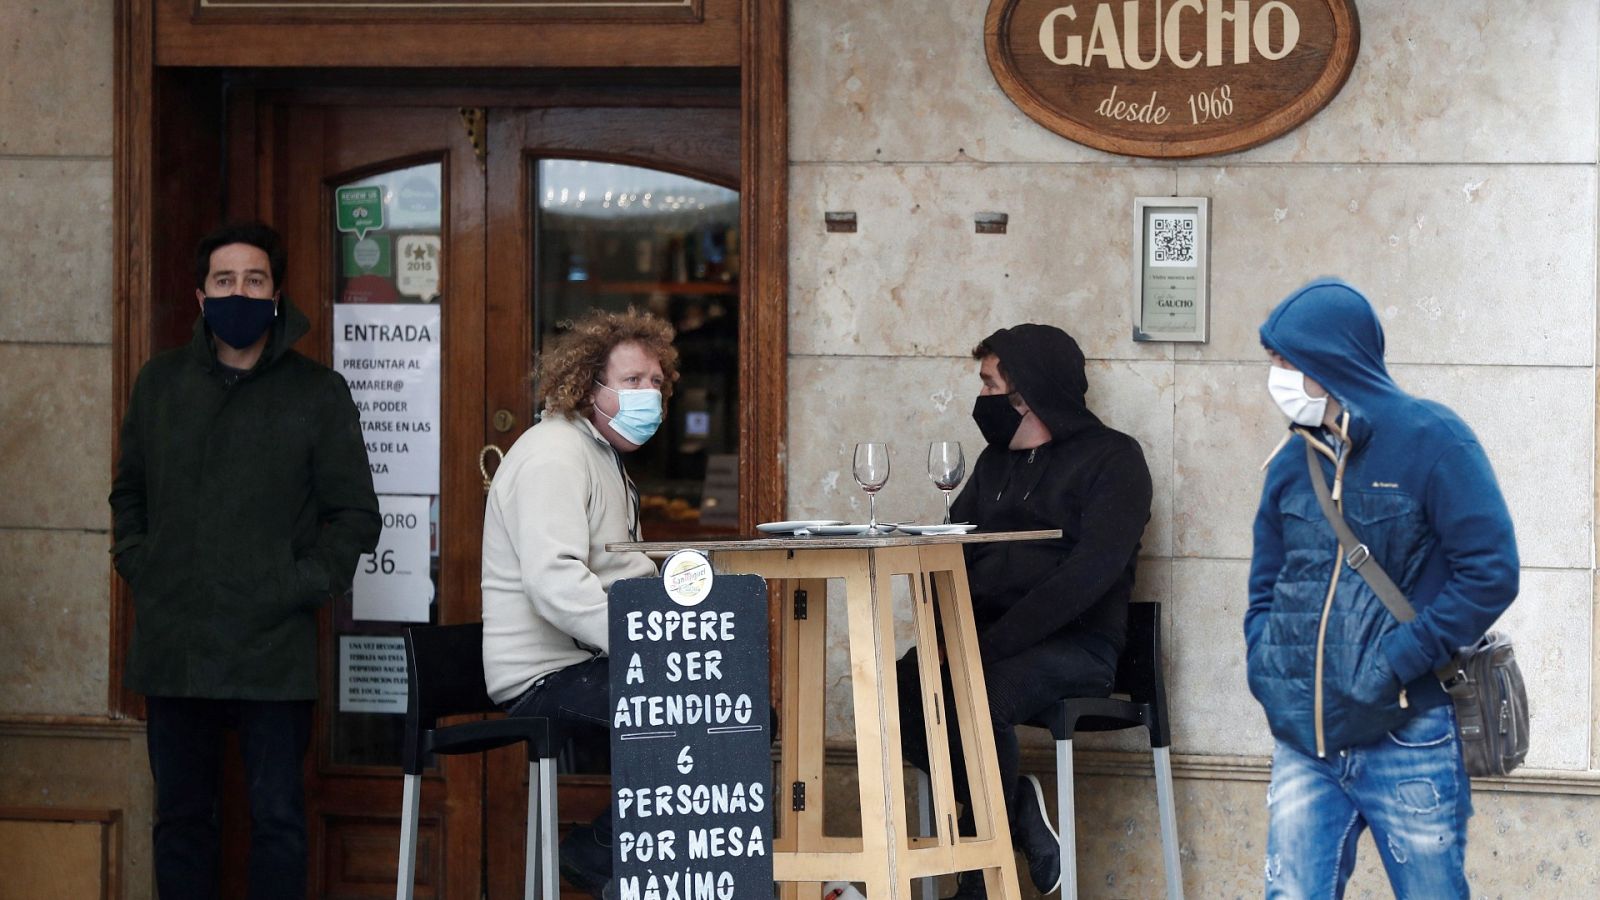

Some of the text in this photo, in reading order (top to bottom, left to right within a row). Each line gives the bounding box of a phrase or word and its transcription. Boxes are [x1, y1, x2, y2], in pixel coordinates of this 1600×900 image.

[1039, 0, 1300, 70] GAUCHO
[1095, 84, 1234, 125] desde 1968
[1158, 300, 1193, 308] GAUCHO
[344, 324, 431, 342] ENTRADA
[343, 359, 421, 370] PREGUNTAR AL
[357, 401, 408, 412] RA PODER
[361, 421, 431, 432] TARSE EN LAS
[380, 442, 393, 453] DE
[396, 443, 409, 453] LA
[370, 463, 389, 474] AZA
[383, 513, 417, 529] ORO
[365, 549, 395, 575] 36
[626, 611, 735, 641] ESPERE
[626, 650, 723, 685] A SER
[614, 692, 752, 728] ATENDIDO
[677, 745, 694, 774] 6
[618, 782, 765, 819] PERSONAS
[619, 825, 765, 862] POR MESA
